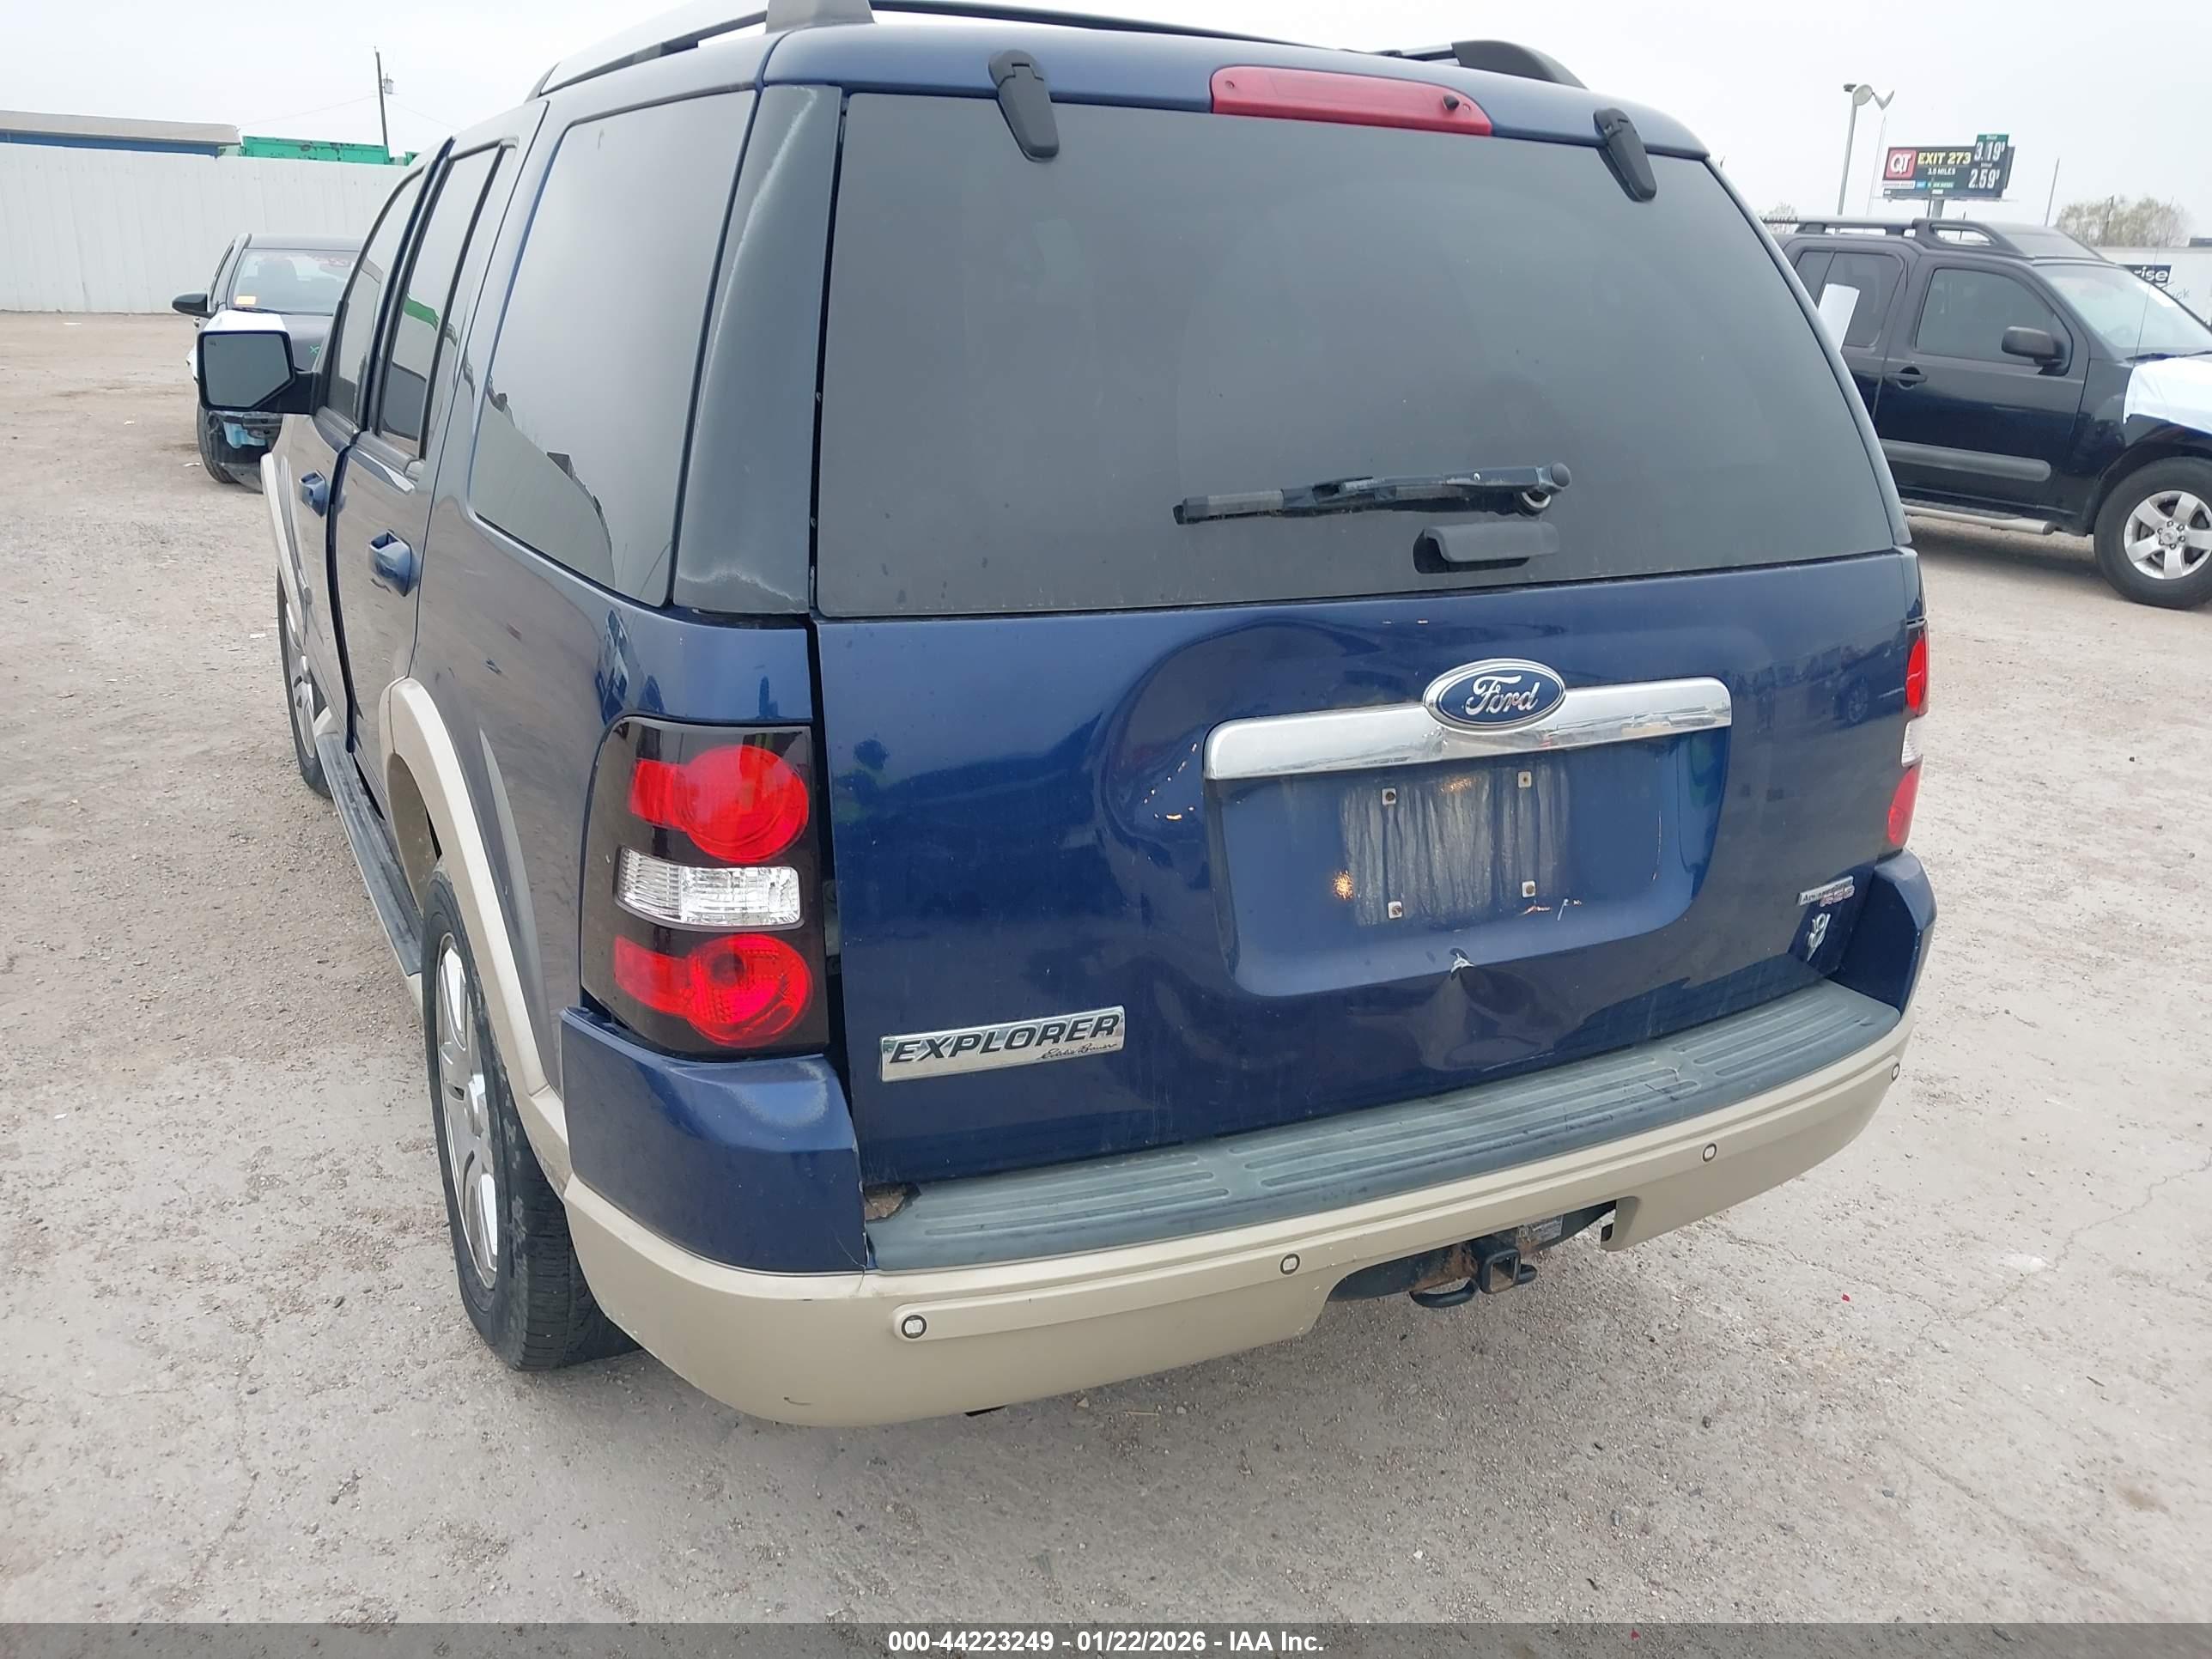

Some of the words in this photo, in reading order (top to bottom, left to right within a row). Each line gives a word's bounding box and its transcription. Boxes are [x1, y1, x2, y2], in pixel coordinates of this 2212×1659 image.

[1890, 153, 1911, 174] QT
[1917, 152, 1946, 166] EXIT
[1947, 151, 1972, 165] 273
[1465, 675, 1540, 715] Ford
[889, 1014, 1120, 1064] EXPLORER
